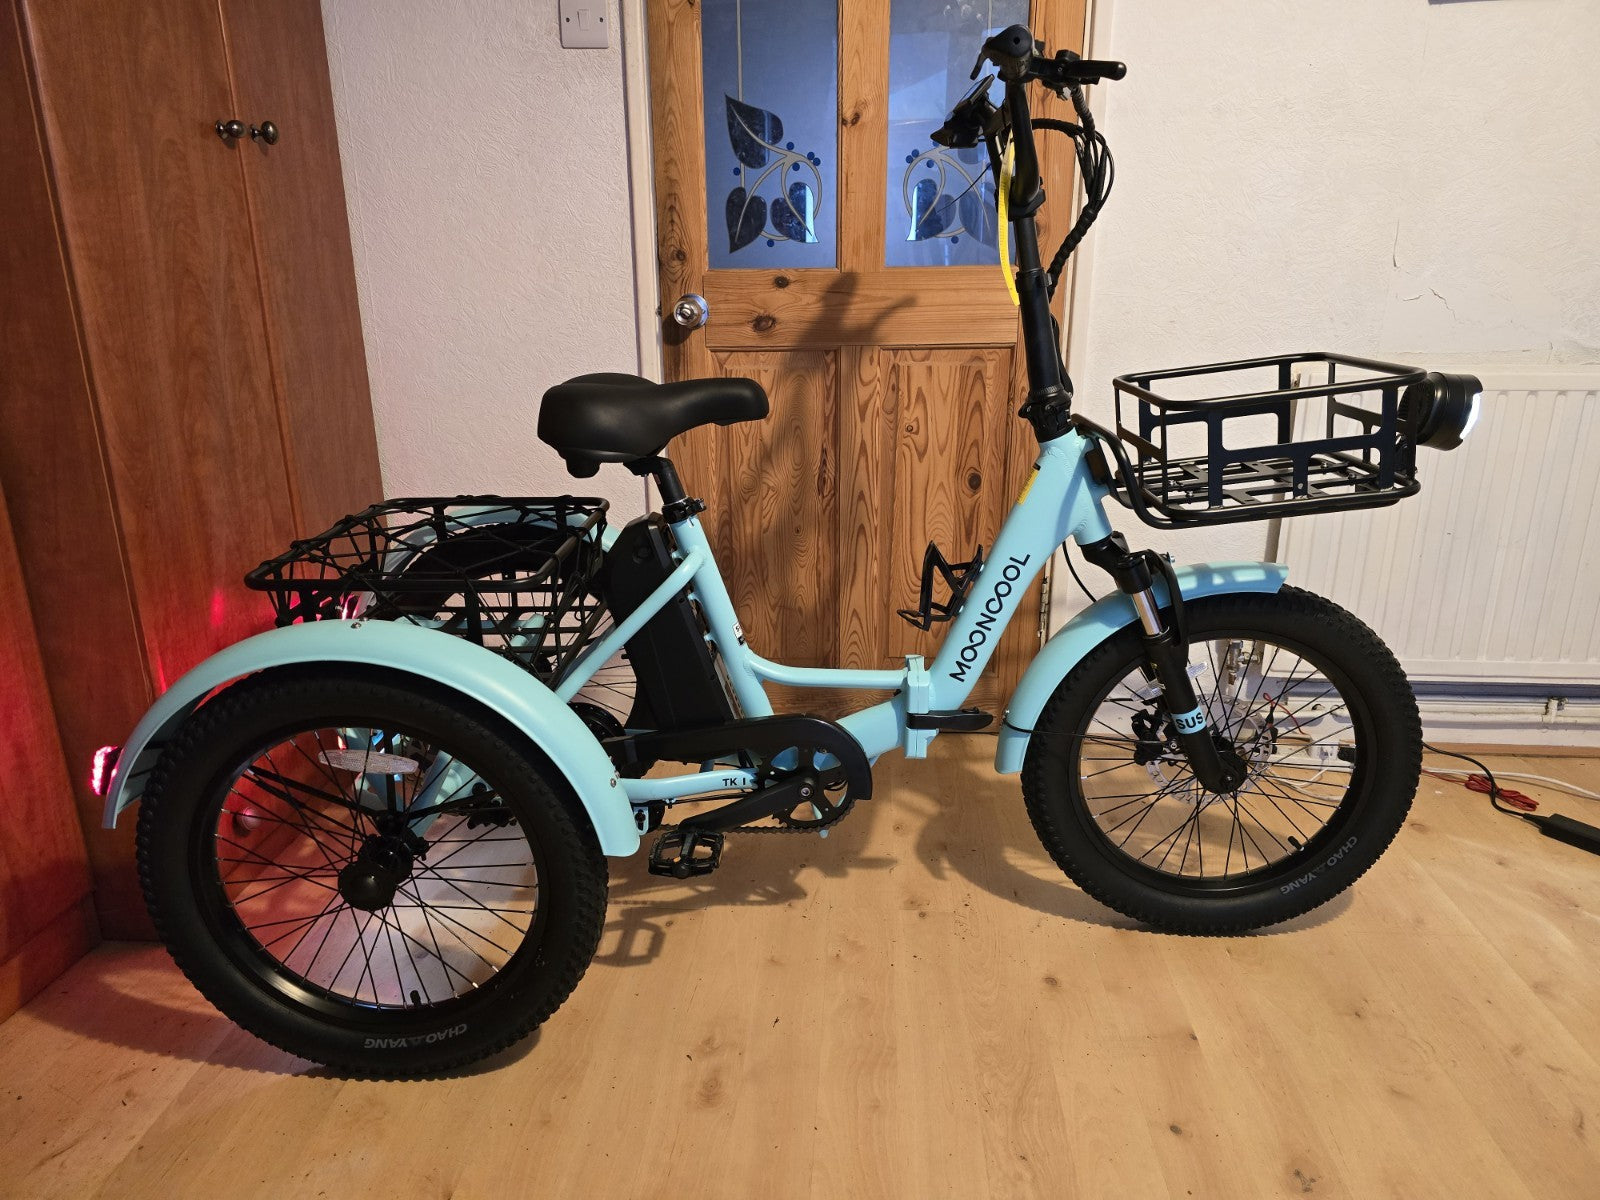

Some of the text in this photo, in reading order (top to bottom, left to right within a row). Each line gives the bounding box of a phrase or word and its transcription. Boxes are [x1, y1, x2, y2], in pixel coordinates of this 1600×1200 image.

[949, 554, 1031, 682] MOONCOOL
[1176, 712, 1204, 730] SUS
[722, 777, 738, 787] TK
[1280, 836, 1358, 894] CHAO YANG
[364, 1023, 468, 1049] CHAO YANG
